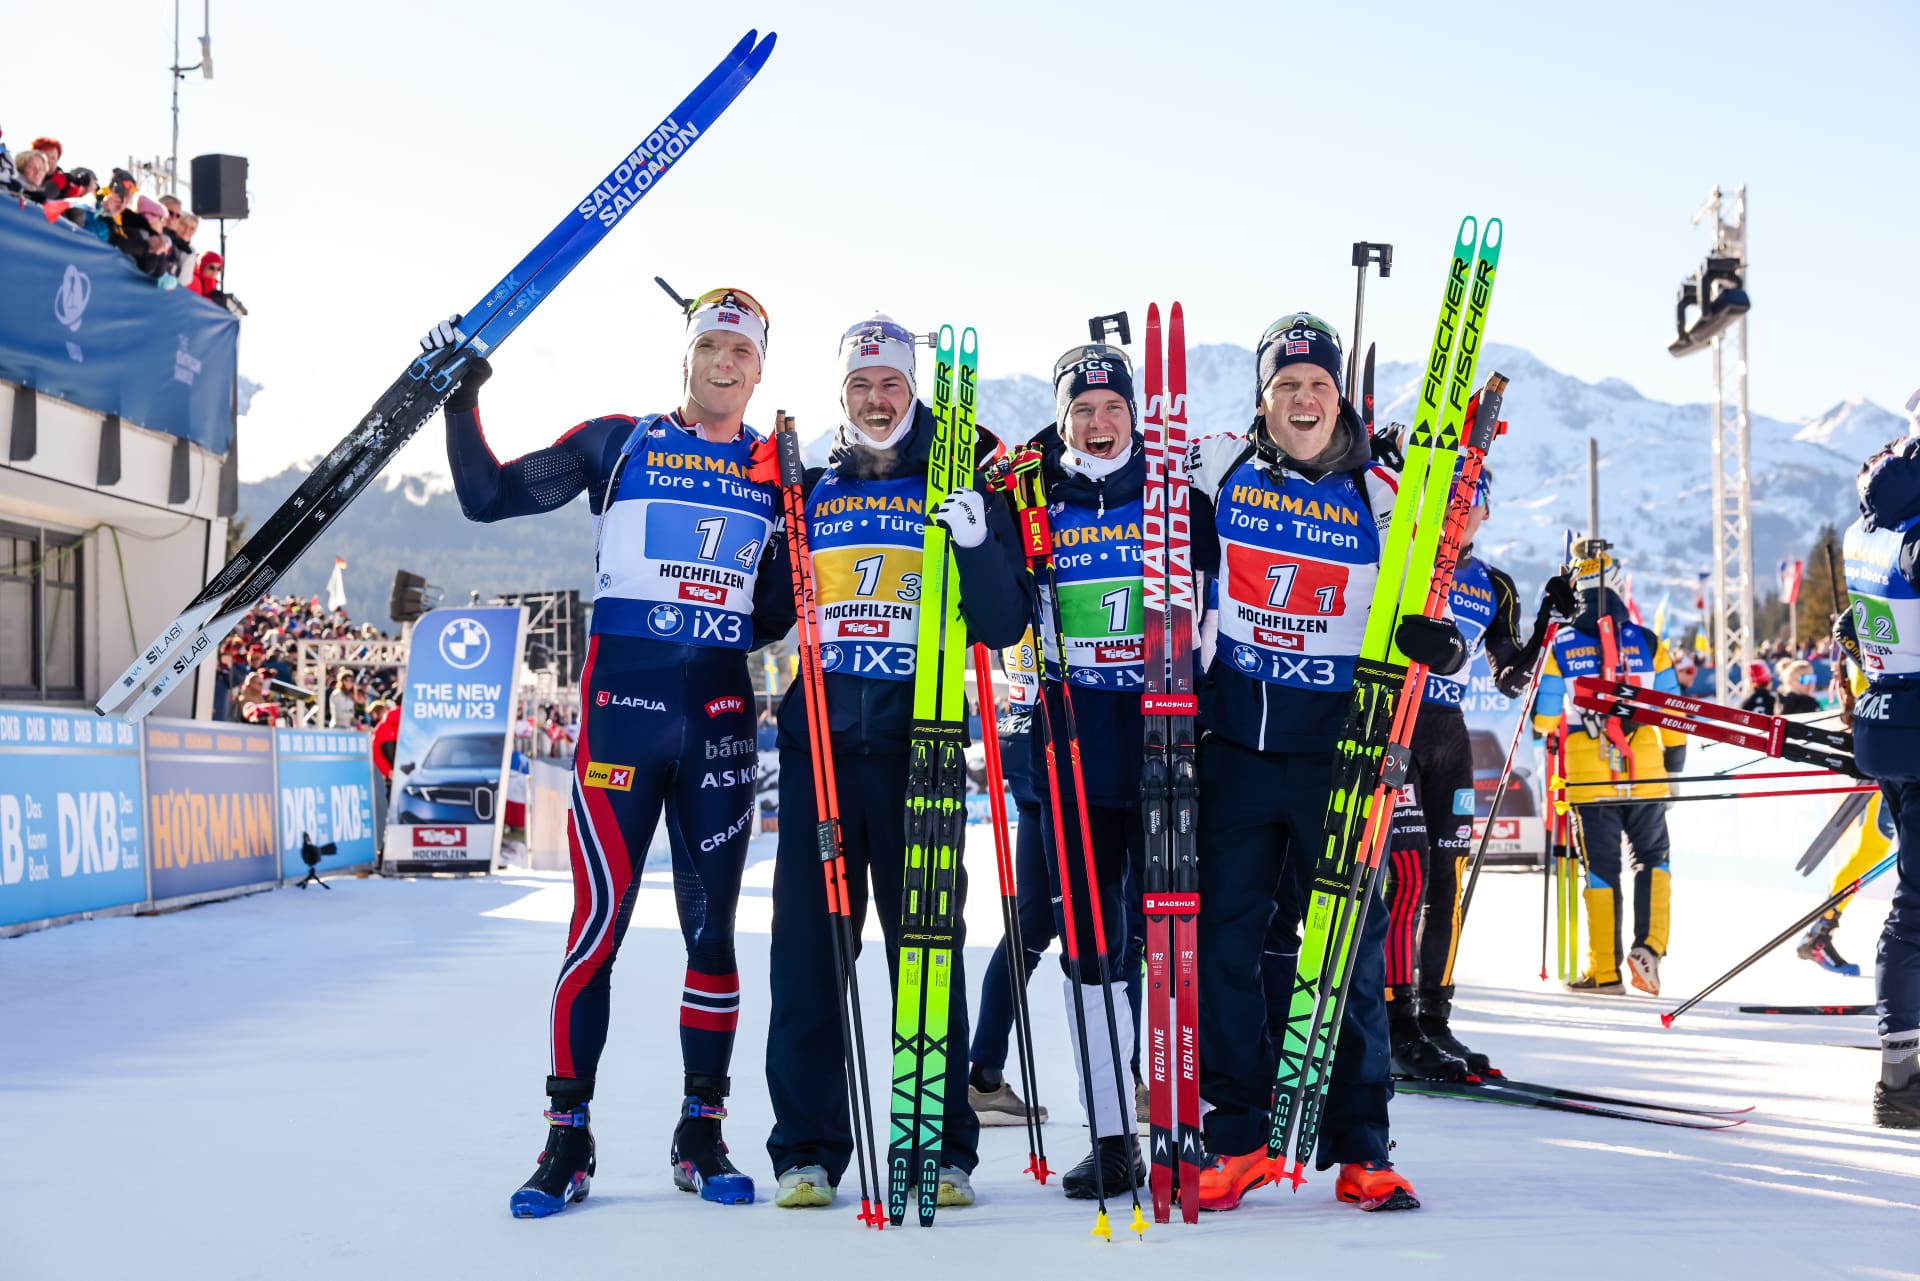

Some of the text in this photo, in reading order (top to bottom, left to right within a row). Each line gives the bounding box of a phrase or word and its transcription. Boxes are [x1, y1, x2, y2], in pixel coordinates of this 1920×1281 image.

[578, 116, 679, 221] SALOMON
[598, 121, 699, 228] SALOMON
[1424, 257, 1469, 410] FISCHER
[1450, 258, 1494, 412] FISCHER
[932, 361, 952, 492] FISCHER
[1482, 396, 1500, 448] ONE WAY
[784, 434, 798, 482] ONE WAY
[646, 471, 772, 506] Tore Türen
[1168, 394, 1193, 610] MADSHUS
[1144, 394, 1166, 612] MADSHUS
[1232, 484, 1358, 526] HÖRMANN
[695, 517, 727, 560] 1
[812, 518, 854, 537] Tore
[1028, 510, 1042, 551] LEKI
[1230, 508, 1269, 532] Tore
[1292, 521, 1358, 549] Türen
[736, 540, 760, 568] 4
[1052, 552, 1092, 570] Tore
[660, 563, 744, 590] HOCHFILZEN
[853, 554, 886, 597] 1
[896, 573, 922, 601] 3
[1266, 564, 1298, 608] 1
[686, 586, 722, 600] Tirol
[1315, 586, 1336, 612] 1
[1454, 594, 1490, 616] Doors
[825, 604, 912, 620] HOCHFILZEN
[1100, 586, 1132, 633] 1
[1238, 605, 1328, 634] HOCHFILZEN
[1856, 600, 1870, 637] 2
[692, 610, 742, 642] iX3
[844, 622, 882, 635] Tirol
[1258, 631, 1298, 648] Tirol
[1875, 617, 1892, 640] 2
[853, 644, 916, 674] iX3
[1021, 644, 1034, 668] 3
[1101, 647, 1140, 660] Tirol
[1568, 659, 1594, 670] Tore
[1272, 656, 1335, 685] iX3
[1357, 666, 1406, 680] FISCHER
[414, 684, 502, 700] THE NEW
[612, 694, 666, 712] LAPUA
[1428, 680, 1460, 702] iX3
[1480, 696, 1510, 711] iX3
[1664, 697, 1700, 712] REDLINE
[414, 703, 495, 720] BMW iX3
[710, 700, 742, 714] MENY
[1662, 717, 1698, 732] REDLINE
[588, 770, 628, 786] Uno X
[26, 795, 42, 819] Das
[121, 792, 134, 815] Das
[330, 784, 362, 843] DKB
[152, 788, 274, 870] HÖRMANN
[281, 788, 318, 850] DKB
[700, 810, 750, 852] CRAFT
[28, 827, 48, 850] kann
[58, 792, 120, 878] DKB
[418, 828, 462, 844] Tirol
[412, 849, 467, 858] HOCHFILZEN
[28, 858, 50, 881] Bank
[1152, 952, 1164, 962] 192
[1181, 950, 1193, 960] 192
[1154, 1027, 1165, 1082] REDLINE
[1183, 1025, 1193, 1081] REDLINE
[1270, 1093, 1291, 1150] SPEED
[892, 1158, 907, 1216] SPEED
[922, 1158, 936, 1217] SPEED
